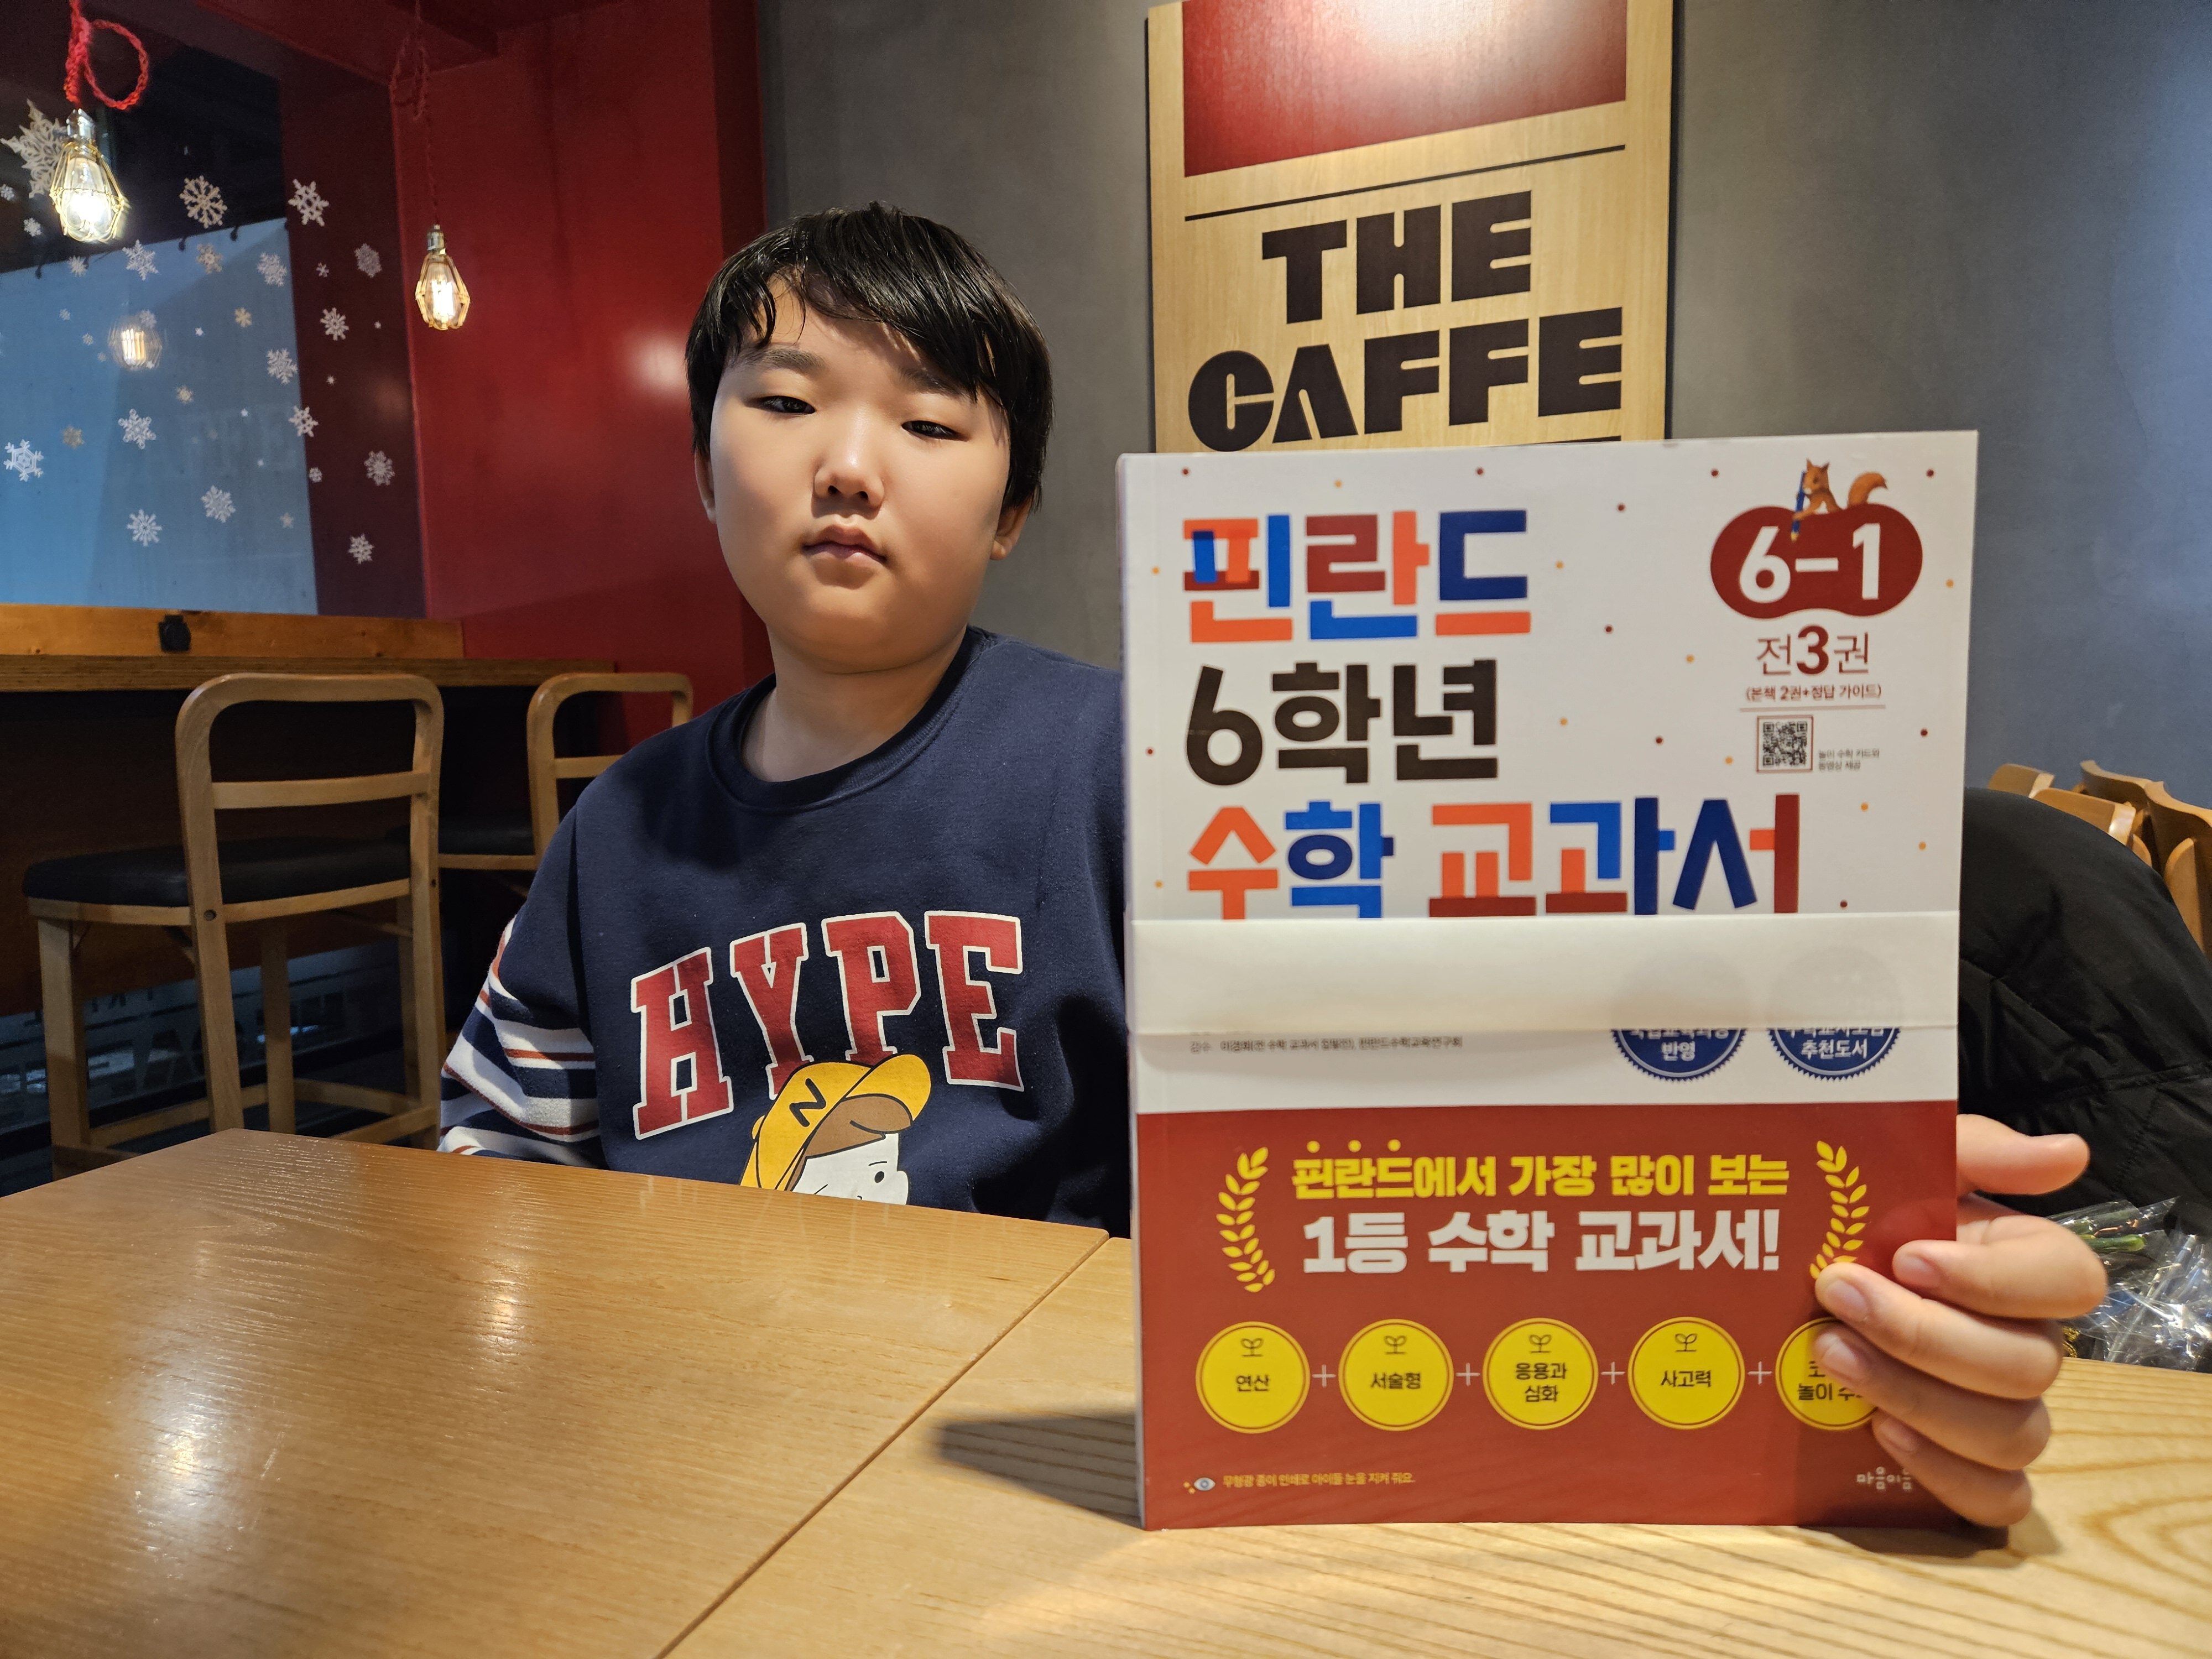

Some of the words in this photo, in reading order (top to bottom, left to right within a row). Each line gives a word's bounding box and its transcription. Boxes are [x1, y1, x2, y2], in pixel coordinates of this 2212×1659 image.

[1262, 190, 1531, 324] THE
[1188, 307, 1622, 452] CAFFE
[1183, 509, 1530, 643] 핀란드
[1740, 523, 1880, 603] 6-1
[1757, 624, 1869, 675] 전3권
[1839, 684, 1882, 698] 가이드)
[1186, 659, 1498, 786] 6학년
[1188, 801, 1394, 919] 수학
[1429, 793, 1799, 916] 교과서
[631, 910, 1025, 1140] HYPE
[1662, 1041, 1695, 1061] 반영
[1801, 1038, 1867, 1060] 추천도서
[789, 1078, 827, 1126] N
[1292, 1156, 1496, 1199] 핀란드에서
[1509, 1155, 1597, 1197] 가장
[1610, 1155, 1694, 1196] 많이
[1708, 1155, 1790, 1196] 보는
[1303, 1212, 1408, 1274] 1등
[1428, 1209, 1554, 1272] 수학
[1575, 1209, 1780, 1271] 교과서!
[1236, 1375, 1269, 1393] 연산
[1370, 1371, 1422, 1391] 서술형
[1514, 1361, 1567, 1381] 응용과
[1660, 1369, 1712, 1388] 사고력
[1798, 1383, 1833, 1401] 놀이
[1525, 1384, 1558, 1403] 심화
[1856, 1467, 1912, 1490] 마음이음
